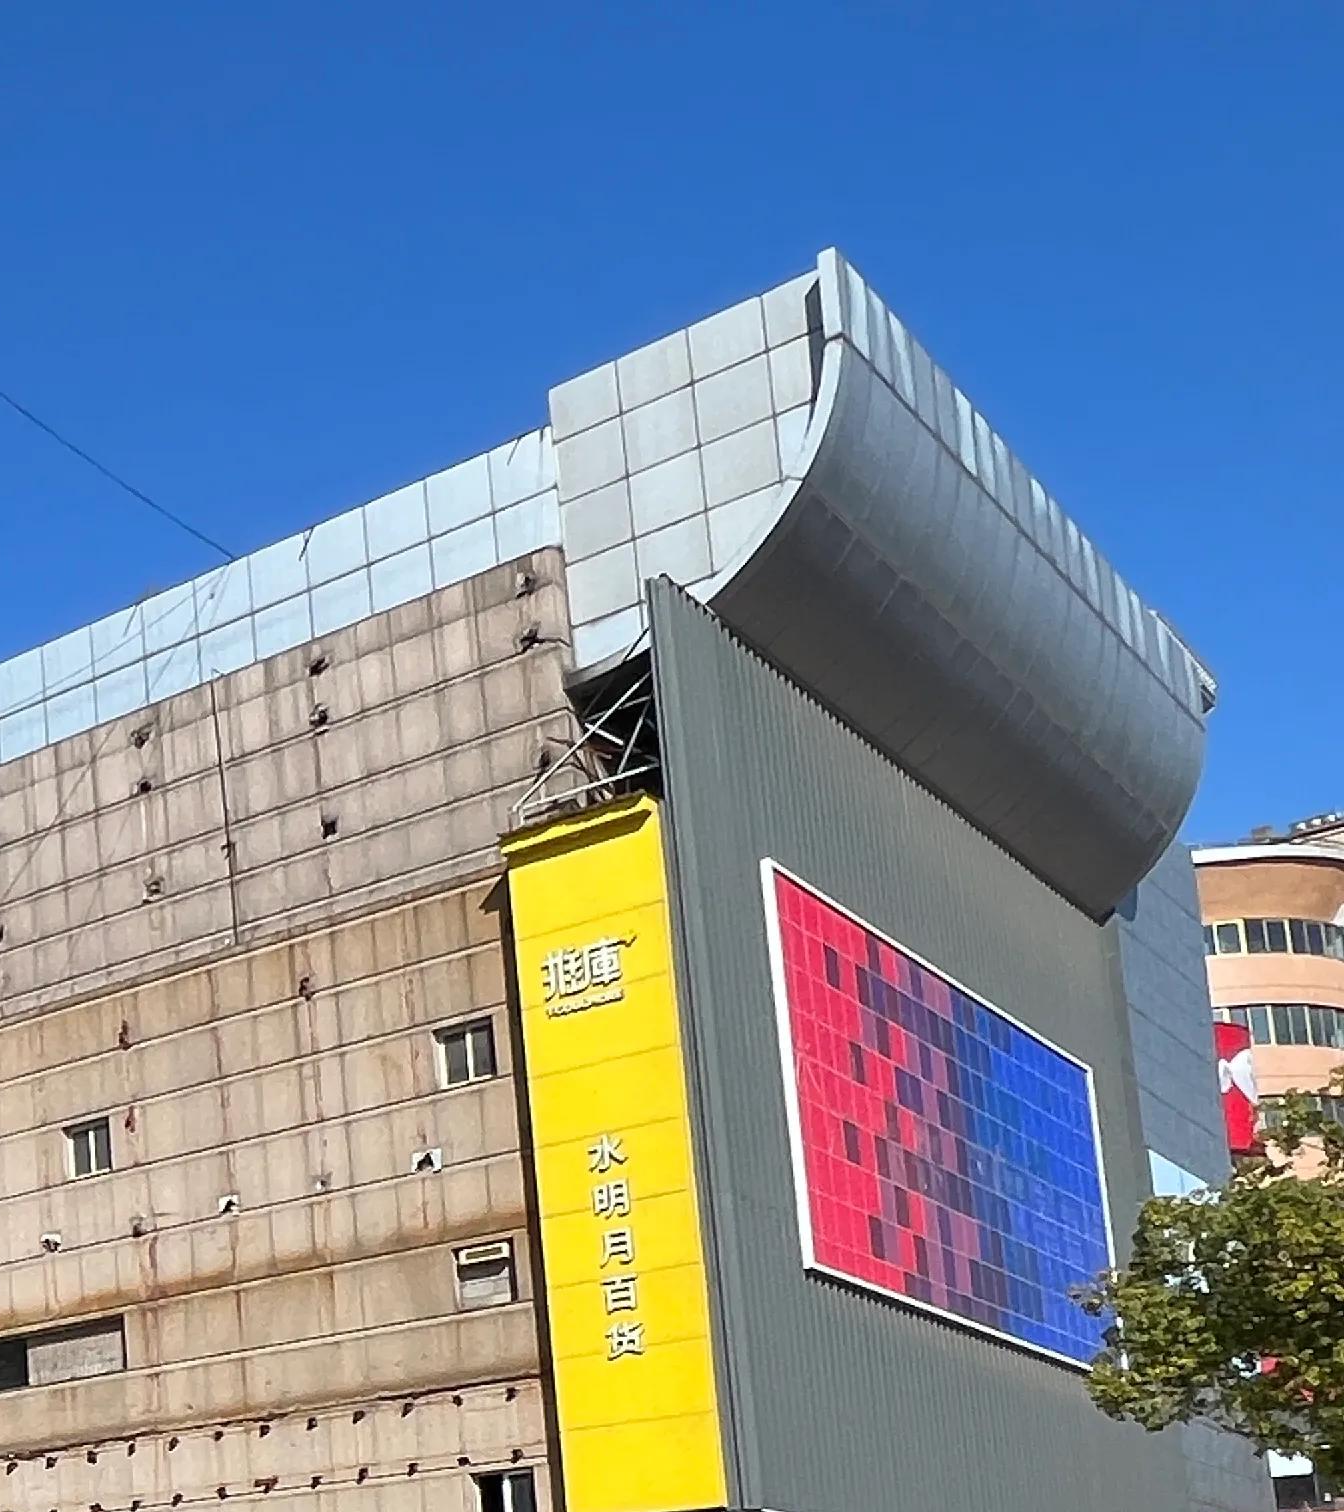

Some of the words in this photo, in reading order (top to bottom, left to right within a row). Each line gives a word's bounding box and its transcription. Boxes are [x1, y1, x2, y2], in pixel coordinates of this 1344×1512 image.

[587, 1134, 645, 1361] 水明月百货
